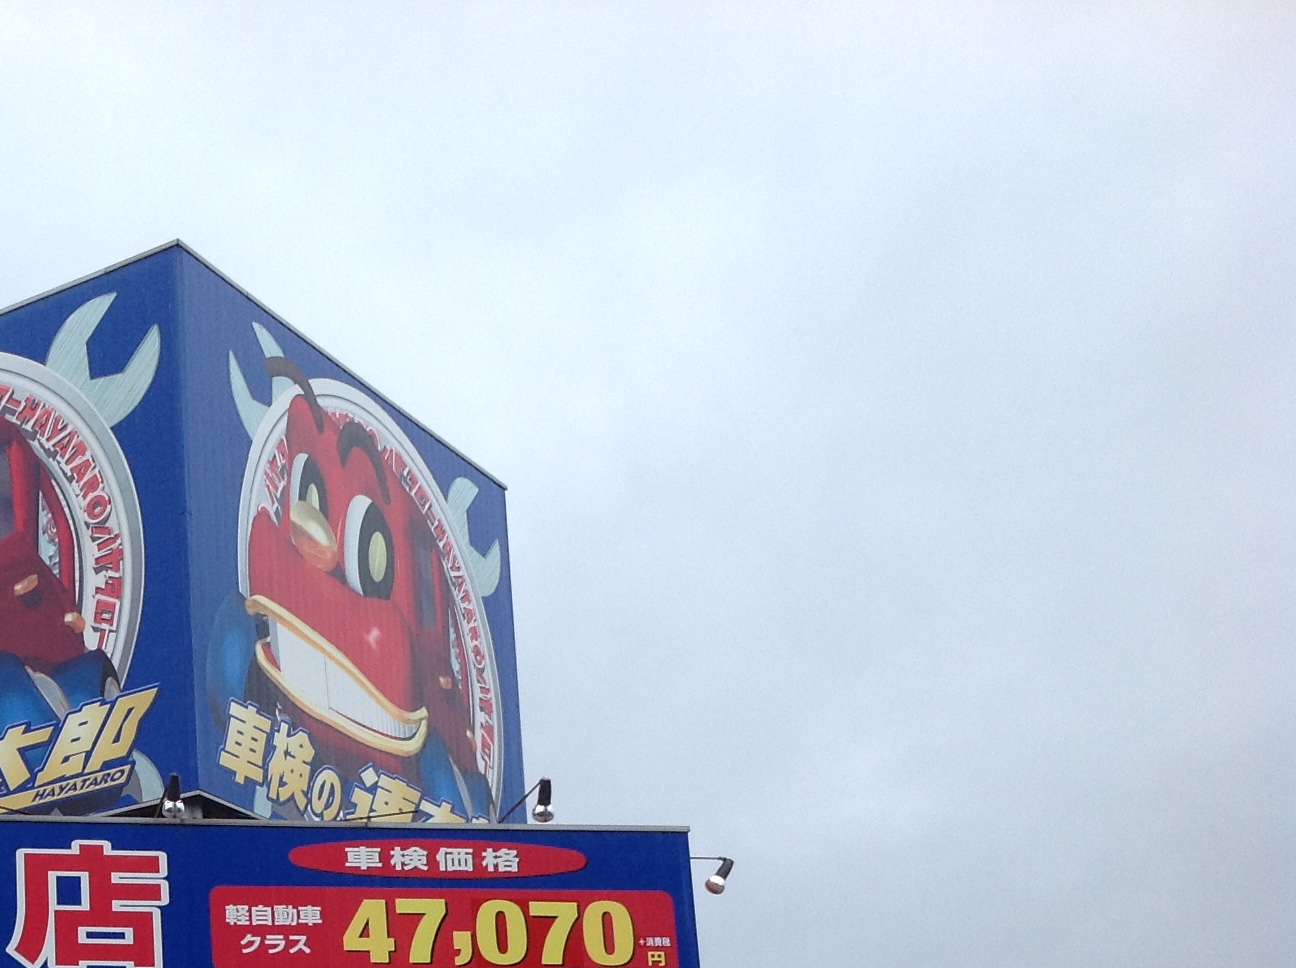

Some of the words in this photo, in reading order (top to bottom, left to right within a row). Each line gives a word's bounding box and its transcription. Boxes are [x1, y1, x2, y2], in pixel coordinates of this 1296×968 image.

[219, 699, 490, 823] 車検の速
[31, 768, 127, 803] HAYATARO
[345, 846, 520, 873] 車検価格
[224, 905, 323, 927] 軽自動車
[240, 934, 312, 955] クラス
[342, 898, 635, 967] 47,070
[647, 951, 667, 967] 円
